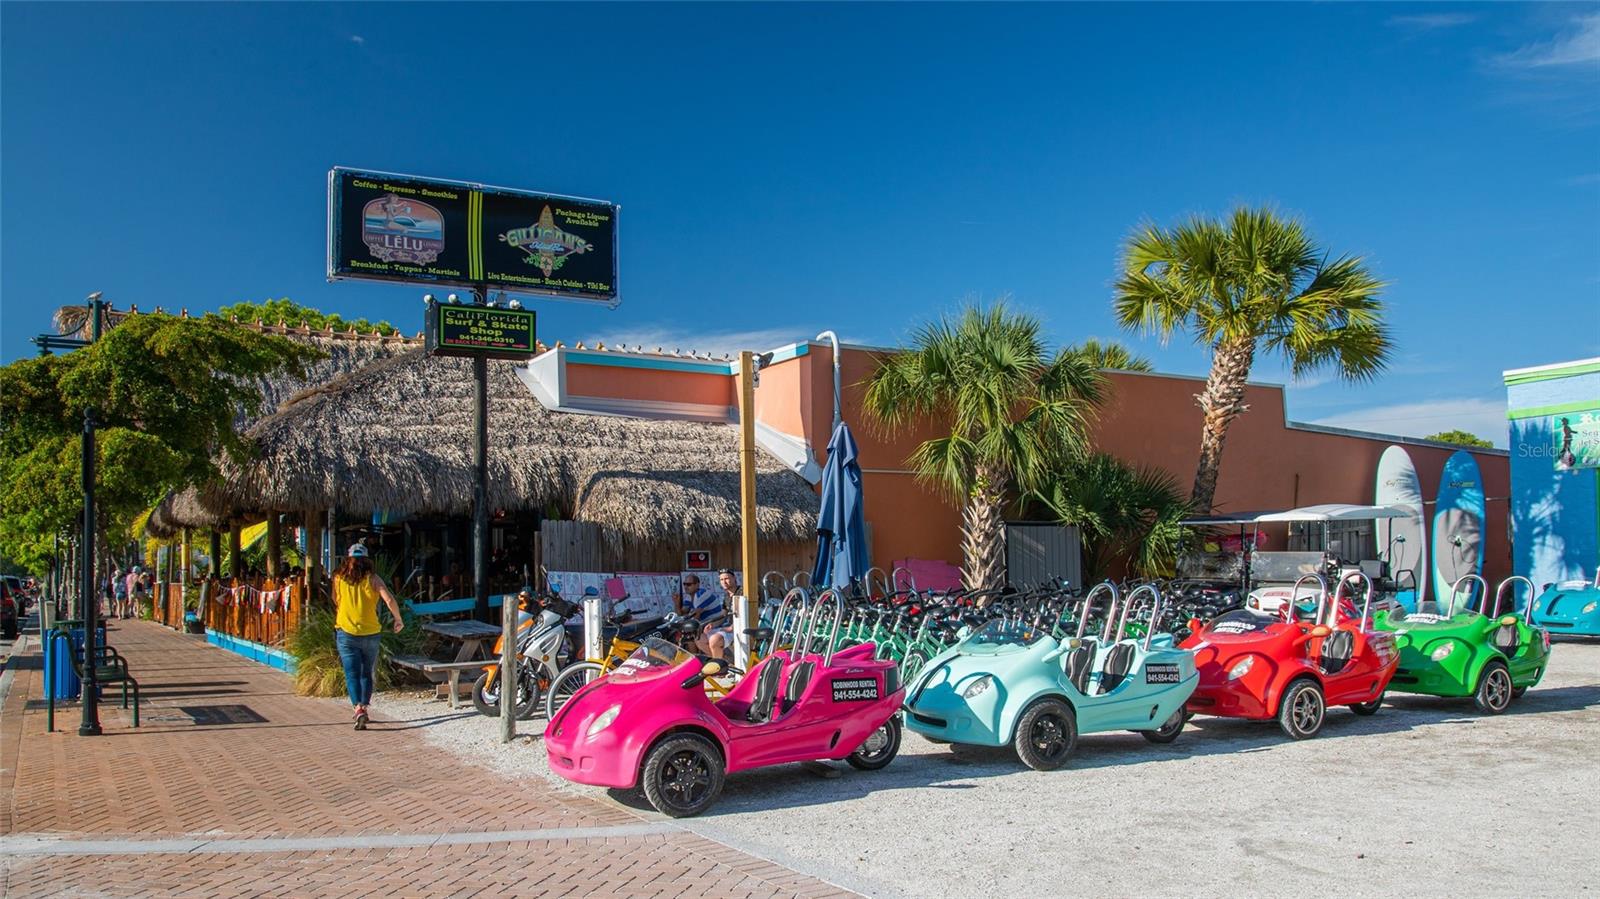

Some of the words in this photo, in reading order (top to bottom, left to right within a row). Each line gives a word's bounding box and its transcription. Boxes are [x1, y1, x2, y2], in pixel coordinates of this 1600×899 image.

[353, 180, 378, 189] Coffee
[383, 184, 416, 195] Espresso
[421, 188, 458, 200] Smoothies
[555, 208, 586, 219] Package
[586, 212, 610, 222] Liquor
[565, 217, 600, 228] Available
[350, 260, 389, 270] Breakfast
[394, 264, 423, 274] Tappas
[428, 267, 460, 277] Martinis
[487, 271, 500, 281] Live
[500, 273, 541, 284] Entertainment
[446, 311, 528, 323] CaliFlorida
[446, 318, 473, 326] Surf
[478, 320, 487, 328] &
[492, 321, 528, 330] Skate
[470, 326, 502, 337] Shop
[833, 688, 878, 701] 941-554-4242
